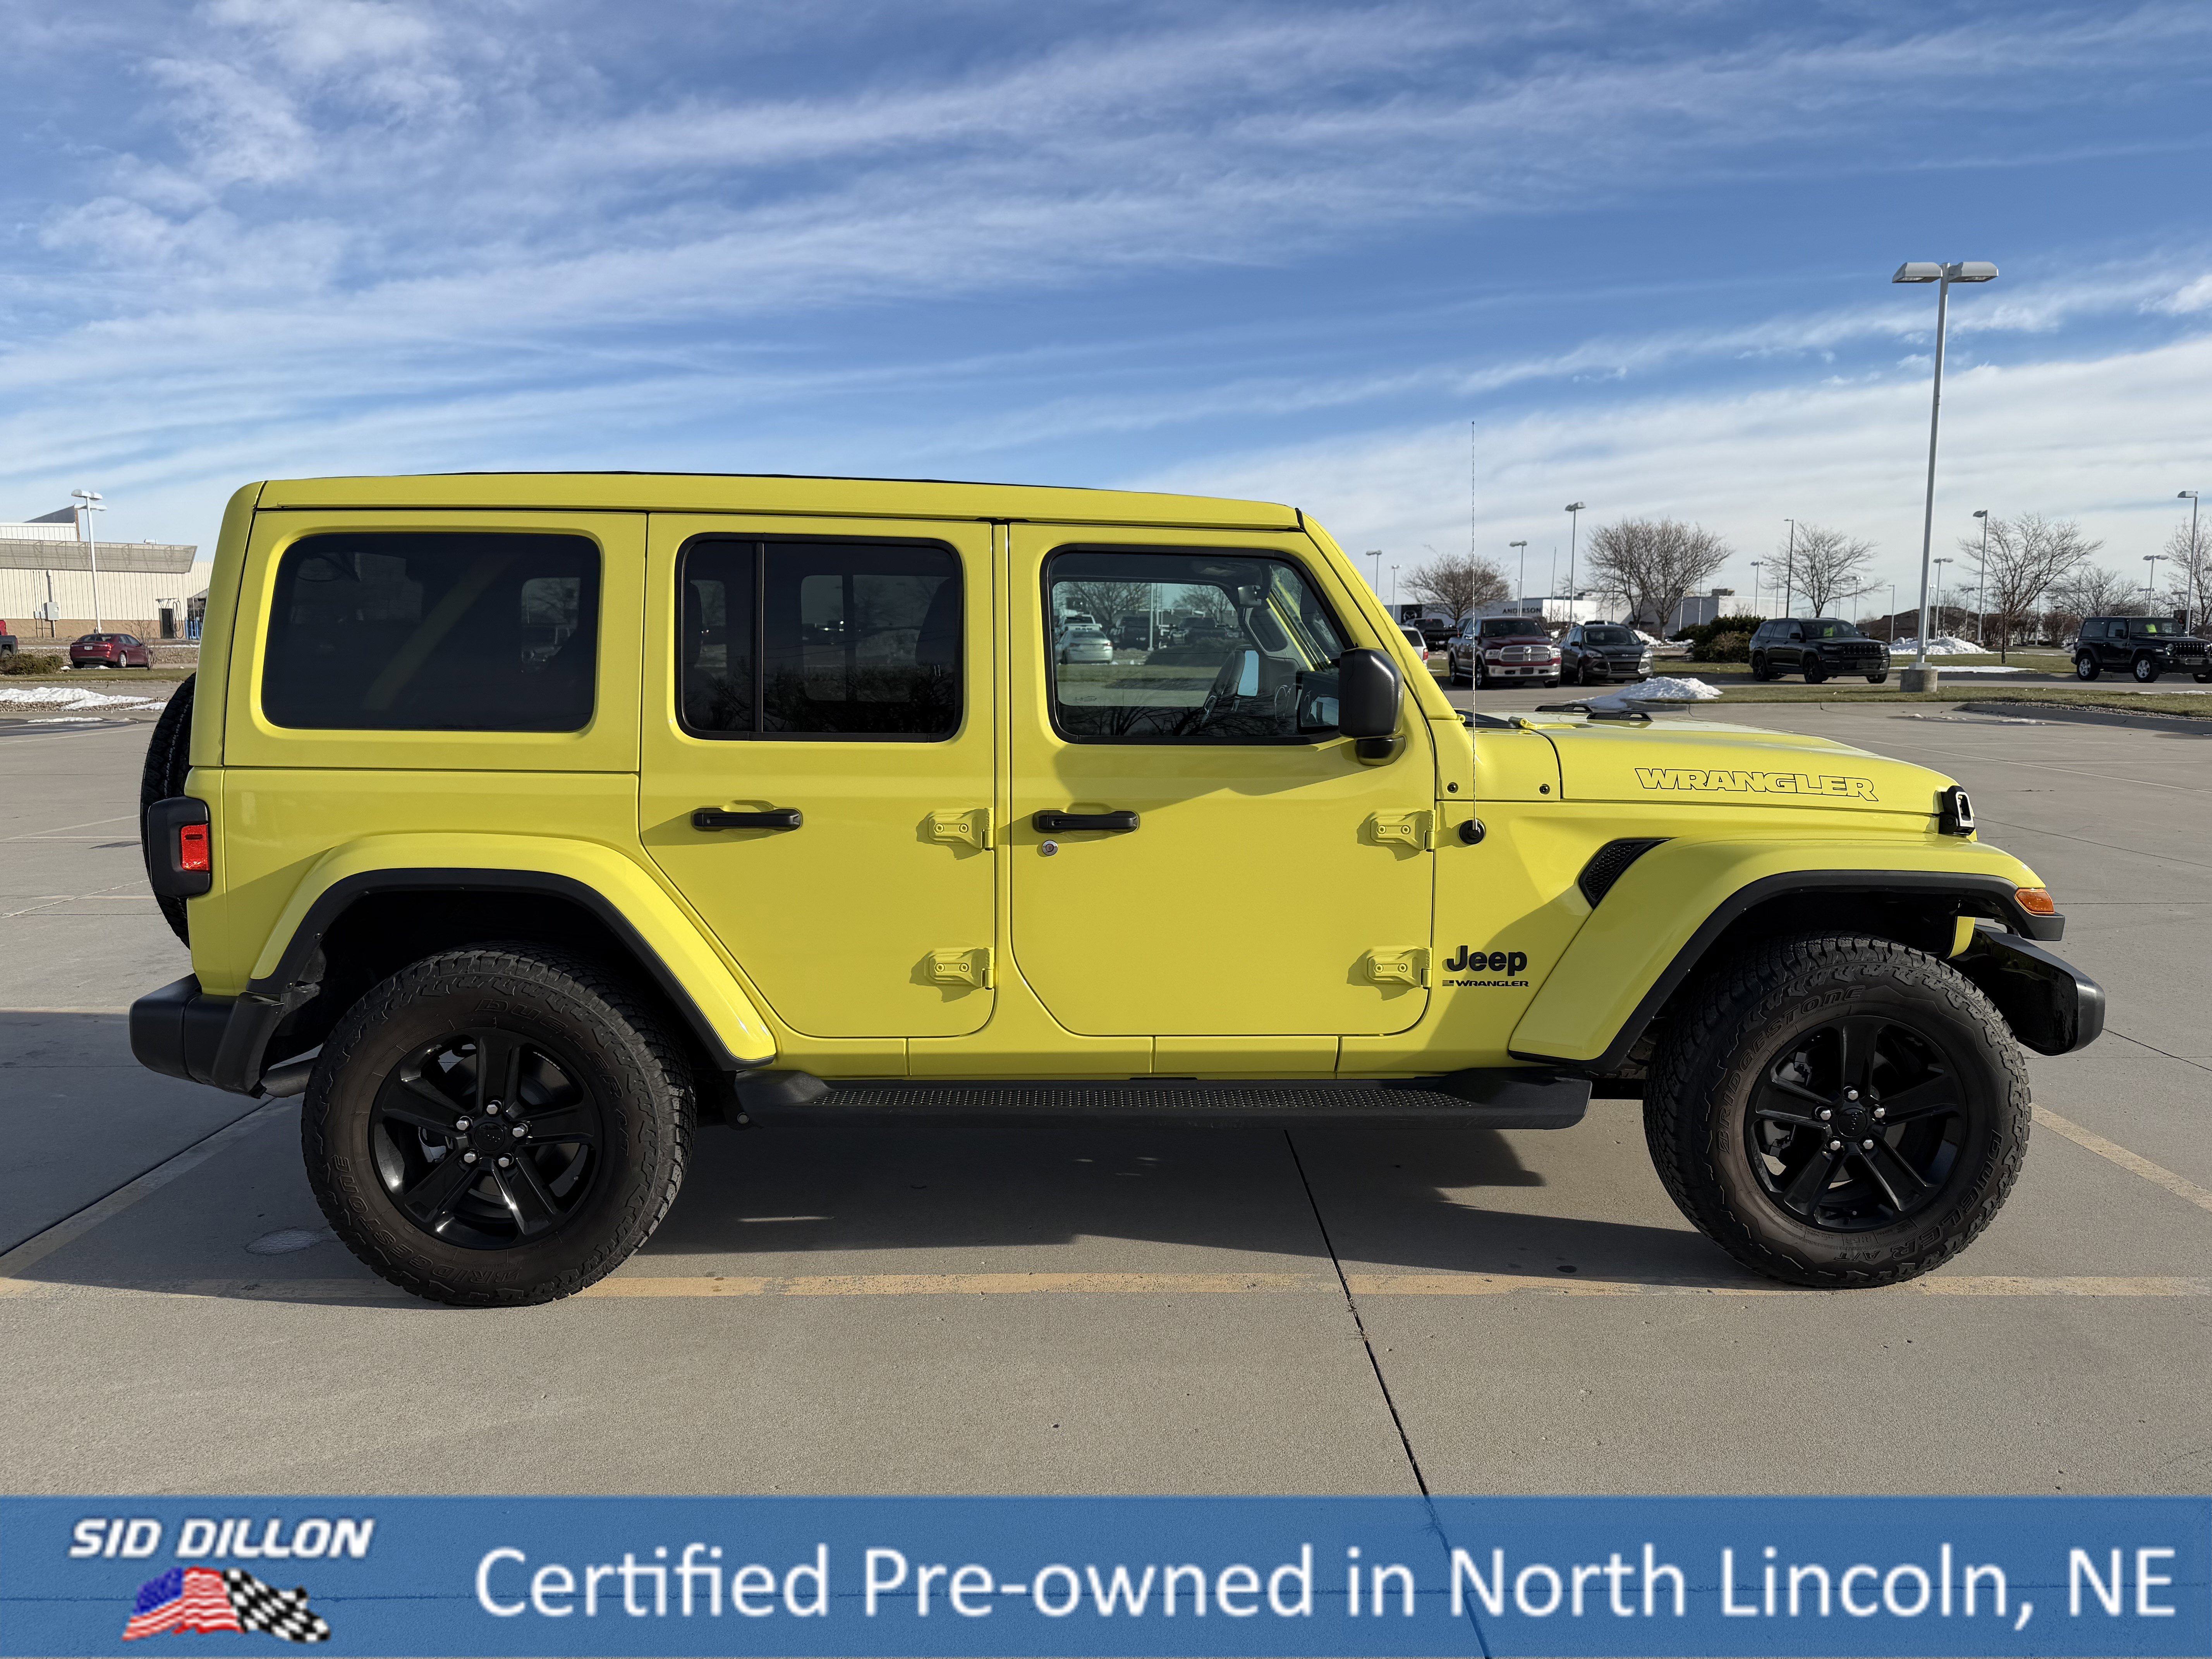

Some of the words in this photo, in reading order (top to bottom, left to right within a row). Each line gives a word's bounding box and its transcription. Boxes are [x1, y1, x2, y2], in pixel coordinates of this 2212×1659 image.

[1635, 768, 1879, 801] WRANGLER
[1446, 945, 1527, 976] Jeep
[1717, 985, 1866, 1154] BRIDGESTONE
[1891, 1129, 2003, 1261] DUELER
